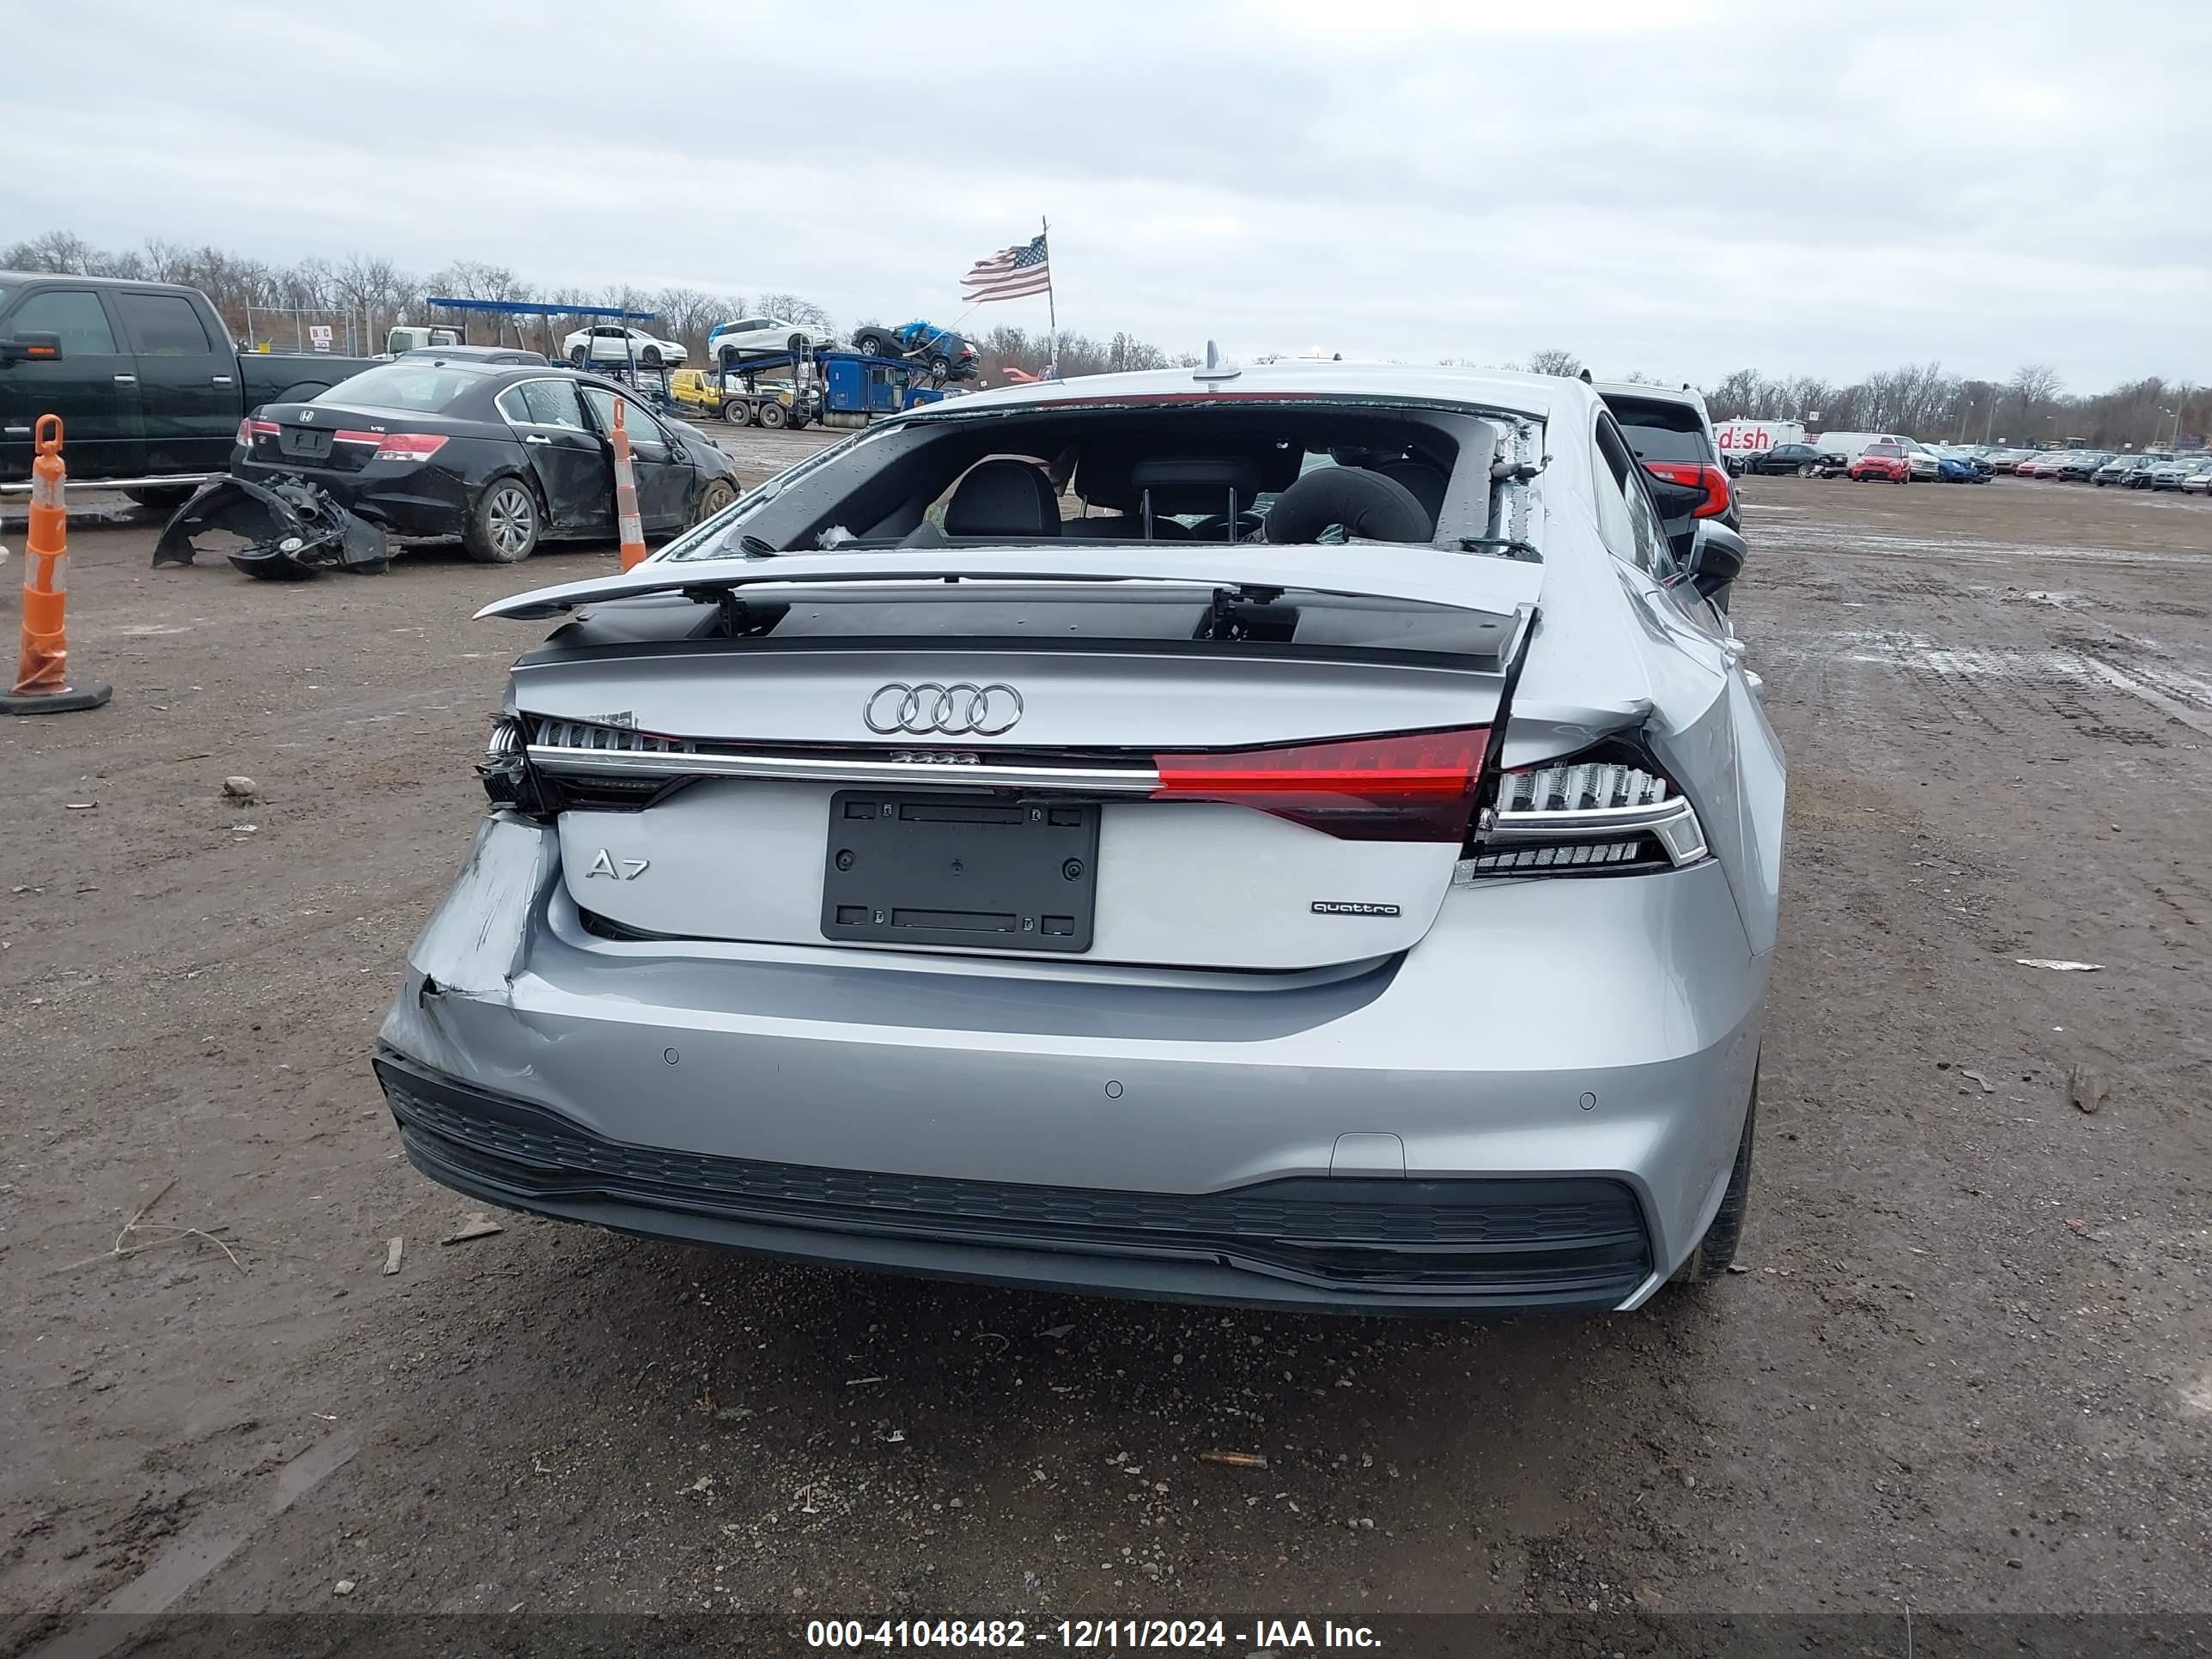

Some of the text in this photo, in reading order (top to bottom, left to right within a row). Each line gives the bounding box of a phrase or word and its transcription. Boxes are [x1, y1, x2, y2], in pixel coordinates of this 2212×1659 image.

[1719, 426, 1769, 450] dish
[585, 848, 650, 881] A7
[1313, 903, 1398, 915] quattro
